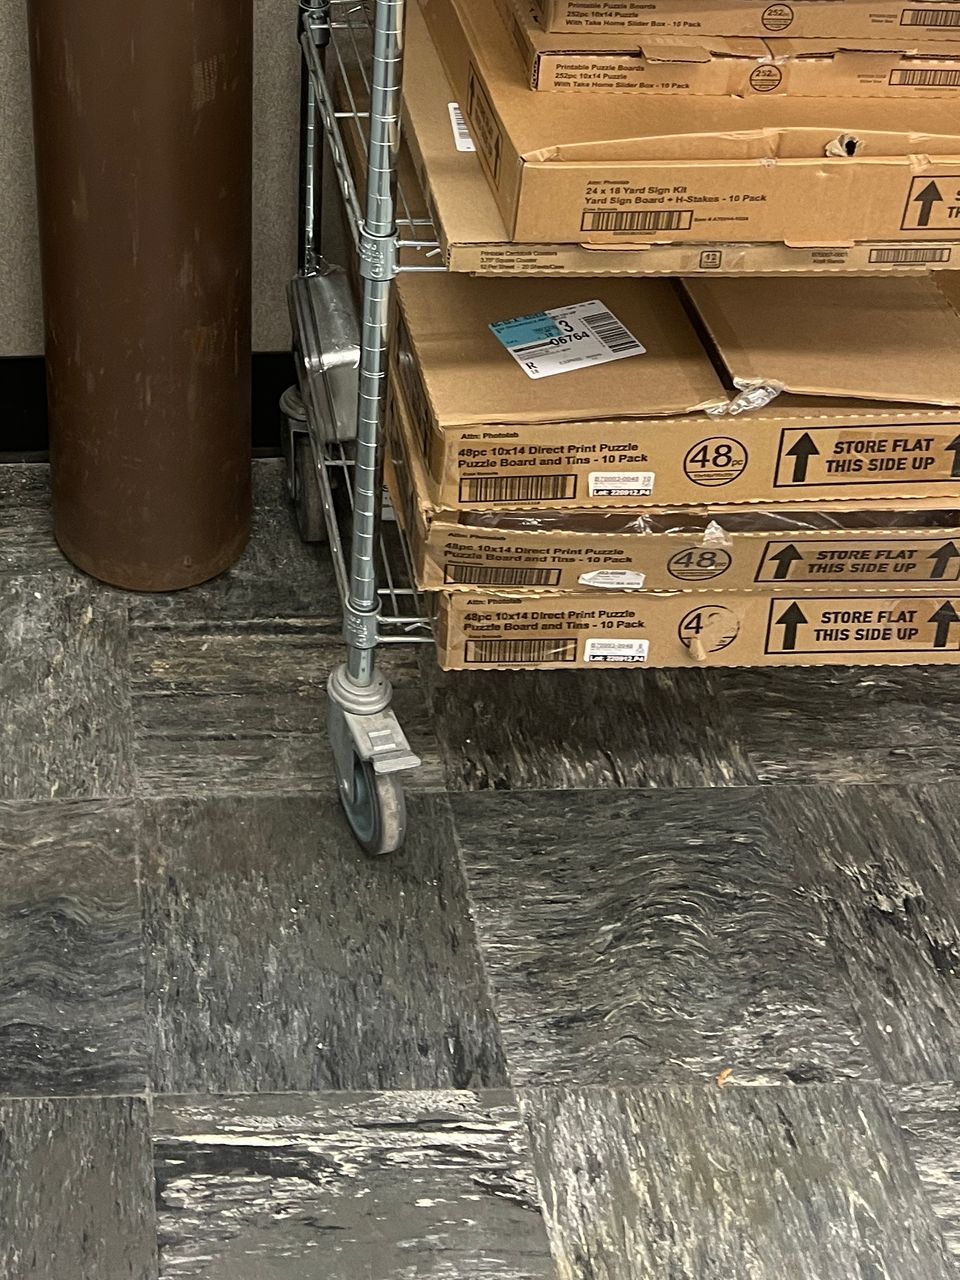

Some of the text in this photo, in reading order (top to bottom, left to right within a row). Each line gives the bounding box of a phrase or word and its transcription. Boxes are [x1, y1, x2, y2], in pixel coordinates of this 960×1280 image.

[602, 2, 629, 10] Puzzle
[565, 19, 583, 27] With
[583, 19, 602, 27] Take
[626, 20, 650, 28] Slider
[650, 20, 666, 28] Box
[682, 20, 702, 28] Pack
[555, 63, 645, 72] Printable Puzzle Boards
[554, 72, 578, 81] 252pc
[553, 81, 571, 89] With
[670, 82, 690, 90] Pack
[586, 187, 598, 195] 24
[622, 186, 646, 194] Yard
[648, 186, 670, 195] Sign
[672, 186, 688, 194] Kit
[585, 197, 608, 205] Yard
[610, 197, 632, 206] Sign
[634, 196, 665, 204] Board
[675, 196, 720, 204] H-Stakes
[728, 194, 740, 202] 10
[742, 194, 767, 202] Pack
[704, 254, 717, 262] 12
[558, 320, 574, 333] 3
[551, 330, 590, 345] 06764
[482, 431, 520, 440] Photolab
[458, 443, 639, 457] 48pc 10x14 Direct Print Puzzle
[833, 438, 936, 455] STORE FLAT
[457, 459, 497, 469] Puzzle
[499, 457, 536, 467] Board
[538, 456, 563, 467] and
[565, 456, 591, 466] Tins
[602, 455, 616, 465] 10
[618, 454, 649, 464] Pack
[826, 456, 936, 473] THIS SIDE UP
[444, 543, 624, 556] 48pc 10x14 Direct Print Puzzle
[816, 550, 918, 560] STORE FLAT
[443, 551, 483, 561] Puzzle
[485, 552, 522, 562] Board
[523, 553, 547, 562] and
[550, 554, 576, 563] Tins
[586, 555, 601, 563] 10
[603, 555, 633, 564] Pack
[808, 562, 917, 574] THIS SIDE UP
[464, 610, 636, 622] 48pc 10x14 Direct Print Puzzle
[821, 610, 918, 624] STORE FLAT
[463, 622, 501, 632] Puzzle
[503, 622, 539, 631] Board
[540, 621, 564, 631] and
[566, 621, 590, 630] Tins
[600, 620, 614, 630] 10
[616, 620, 646, 629] Pack
[814, 628, 919, 642] THIS SIDE UP
